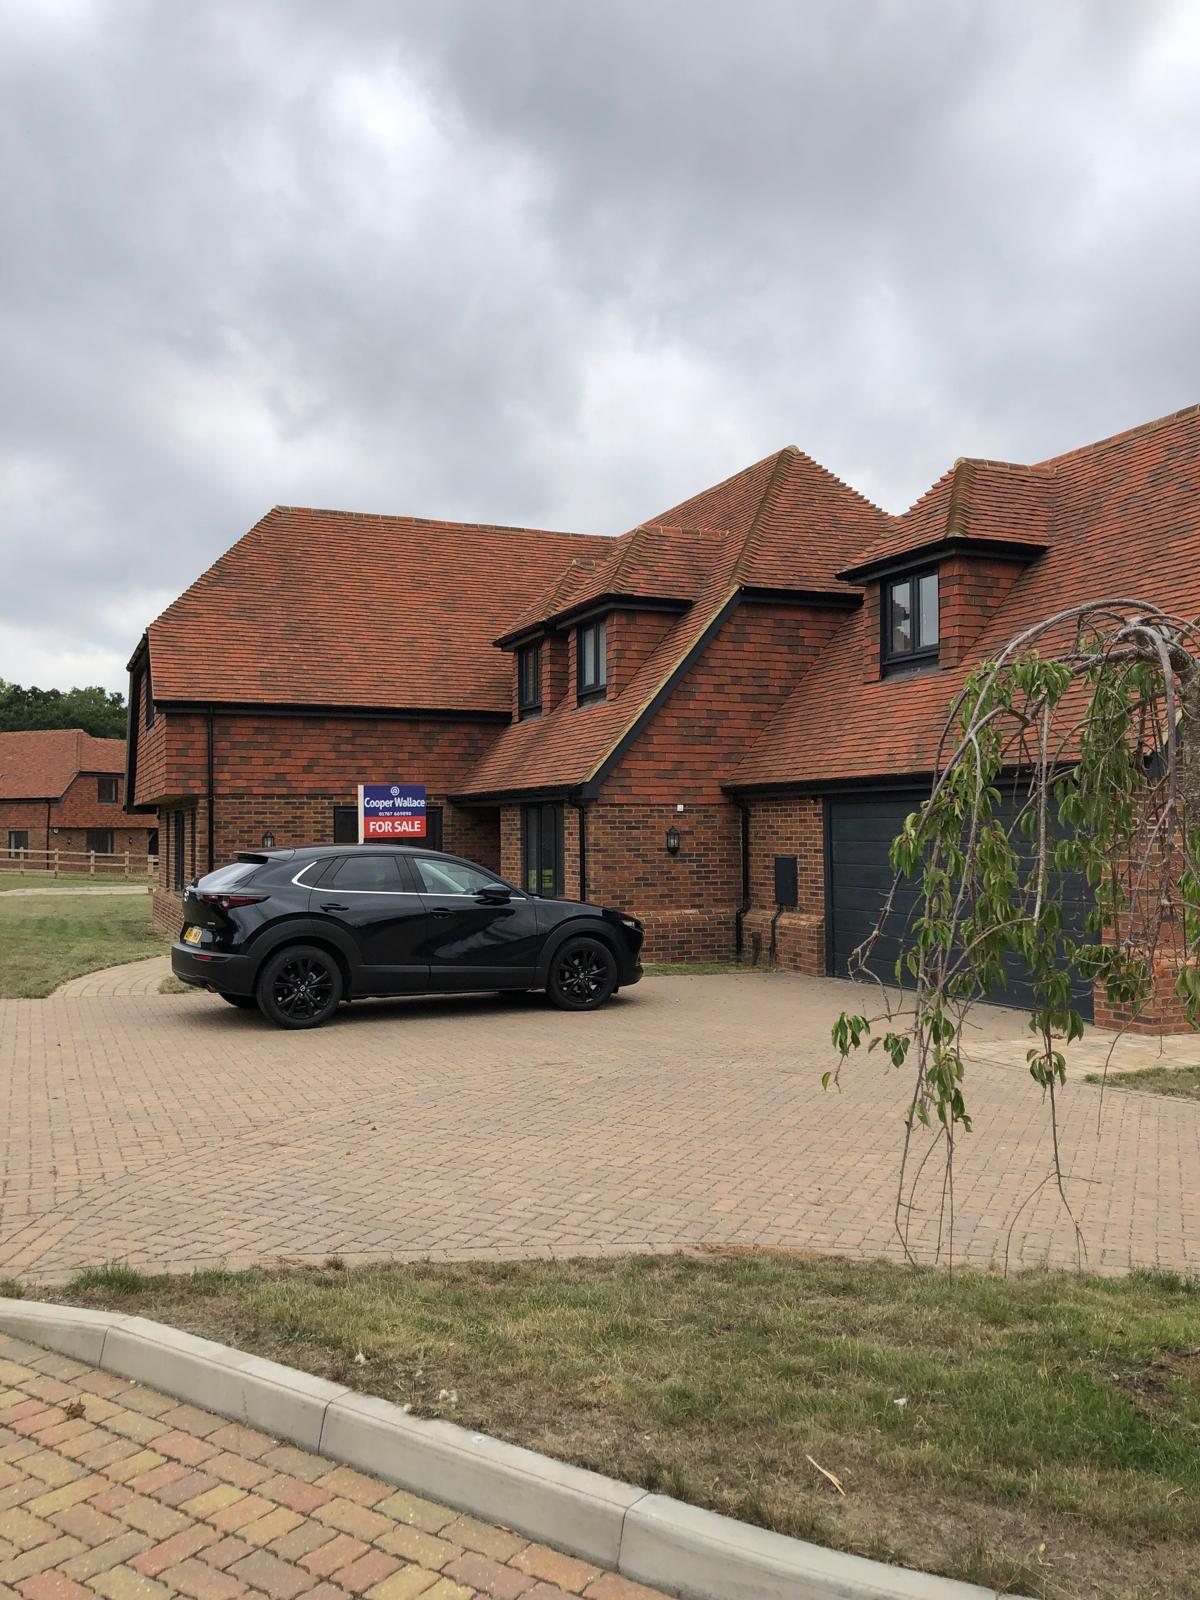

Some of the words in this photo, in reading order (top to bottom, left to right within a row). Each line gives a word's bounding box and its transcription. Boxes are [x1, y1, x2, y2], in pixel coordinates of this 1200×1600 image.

[364, 797, 393, 810] Cooper
[394, 797, 425, 807] Wallace
[369, 821, 393, 833] FOR
[394, 820, 421, 832] SALE
